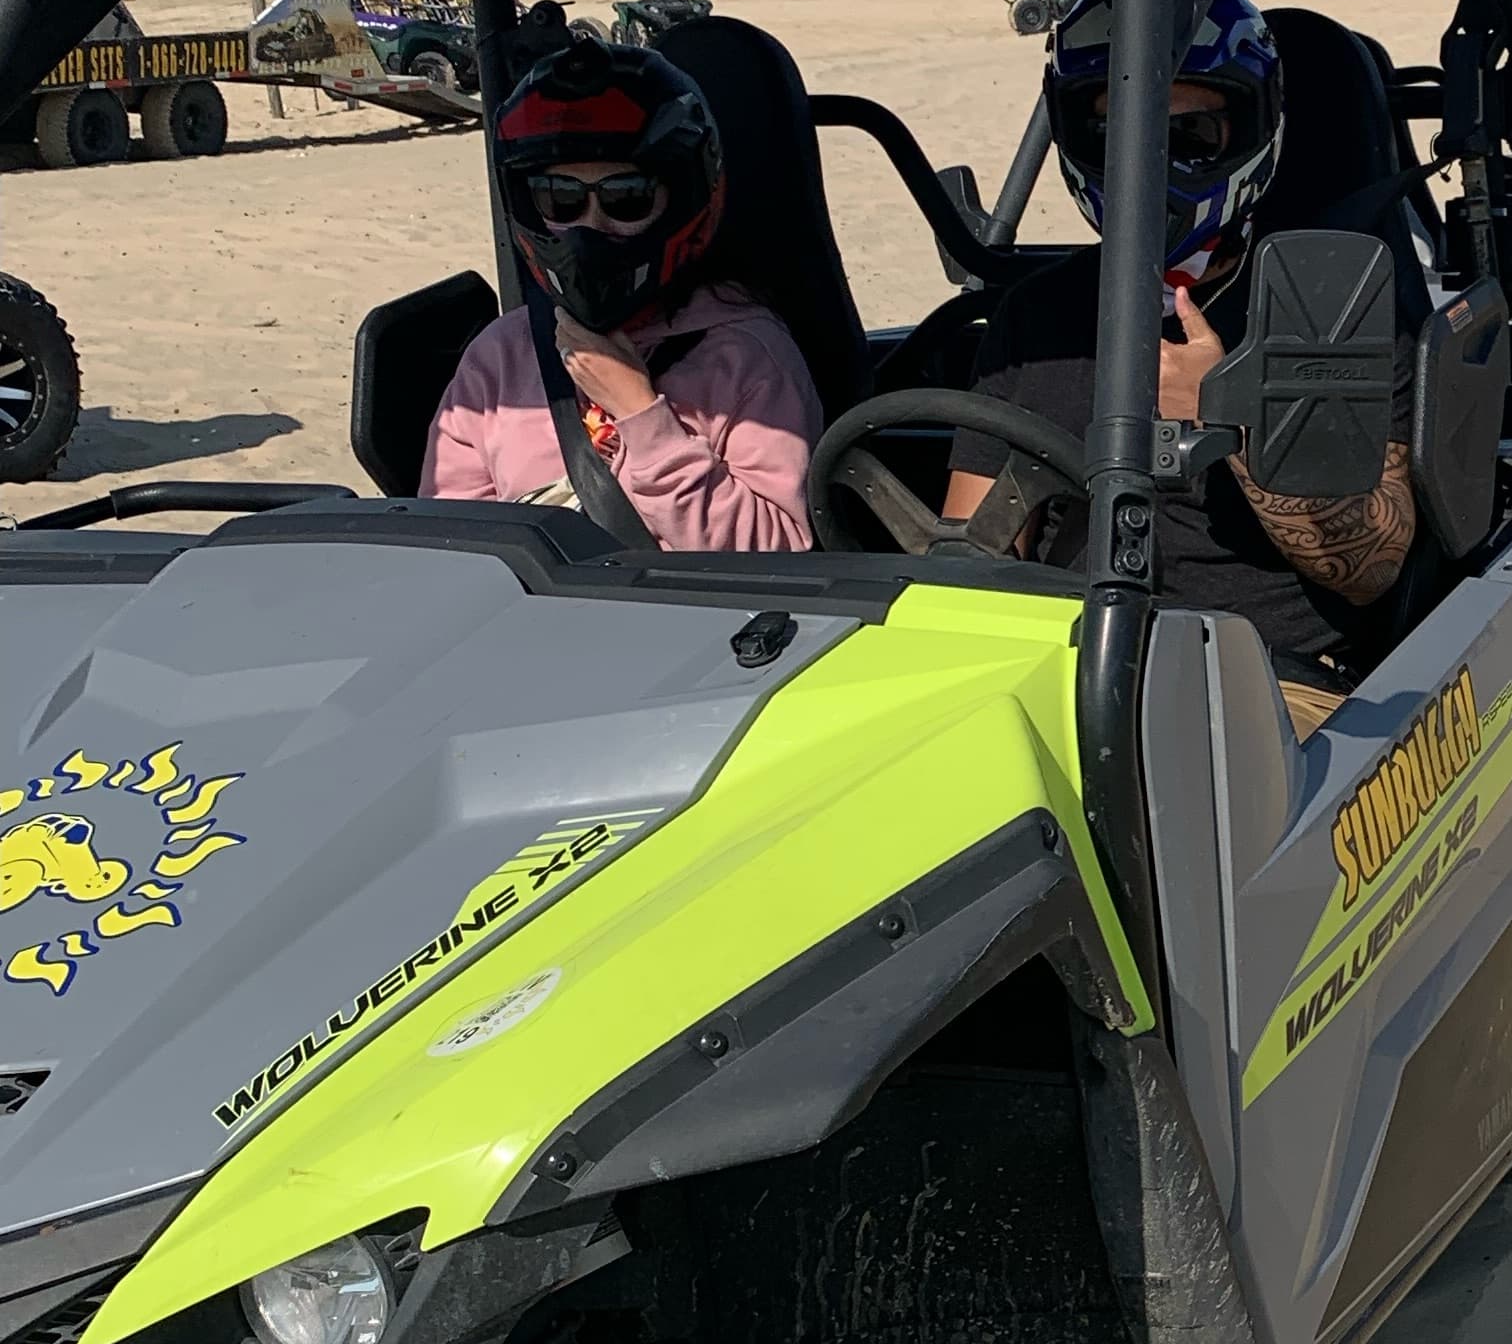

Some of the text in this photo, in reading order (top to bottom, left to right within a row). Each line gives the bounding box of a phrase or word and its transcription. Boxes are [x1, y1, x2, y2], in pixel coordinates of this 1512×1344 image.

[90, 46, 124, 81] SETS
[1331, 663, 1481, 912] SUNBUGGY
[212, 823, 611, 1128] WOLVERINE X2
[1286, 795, 1478, 1056] WOLVERINE X2
